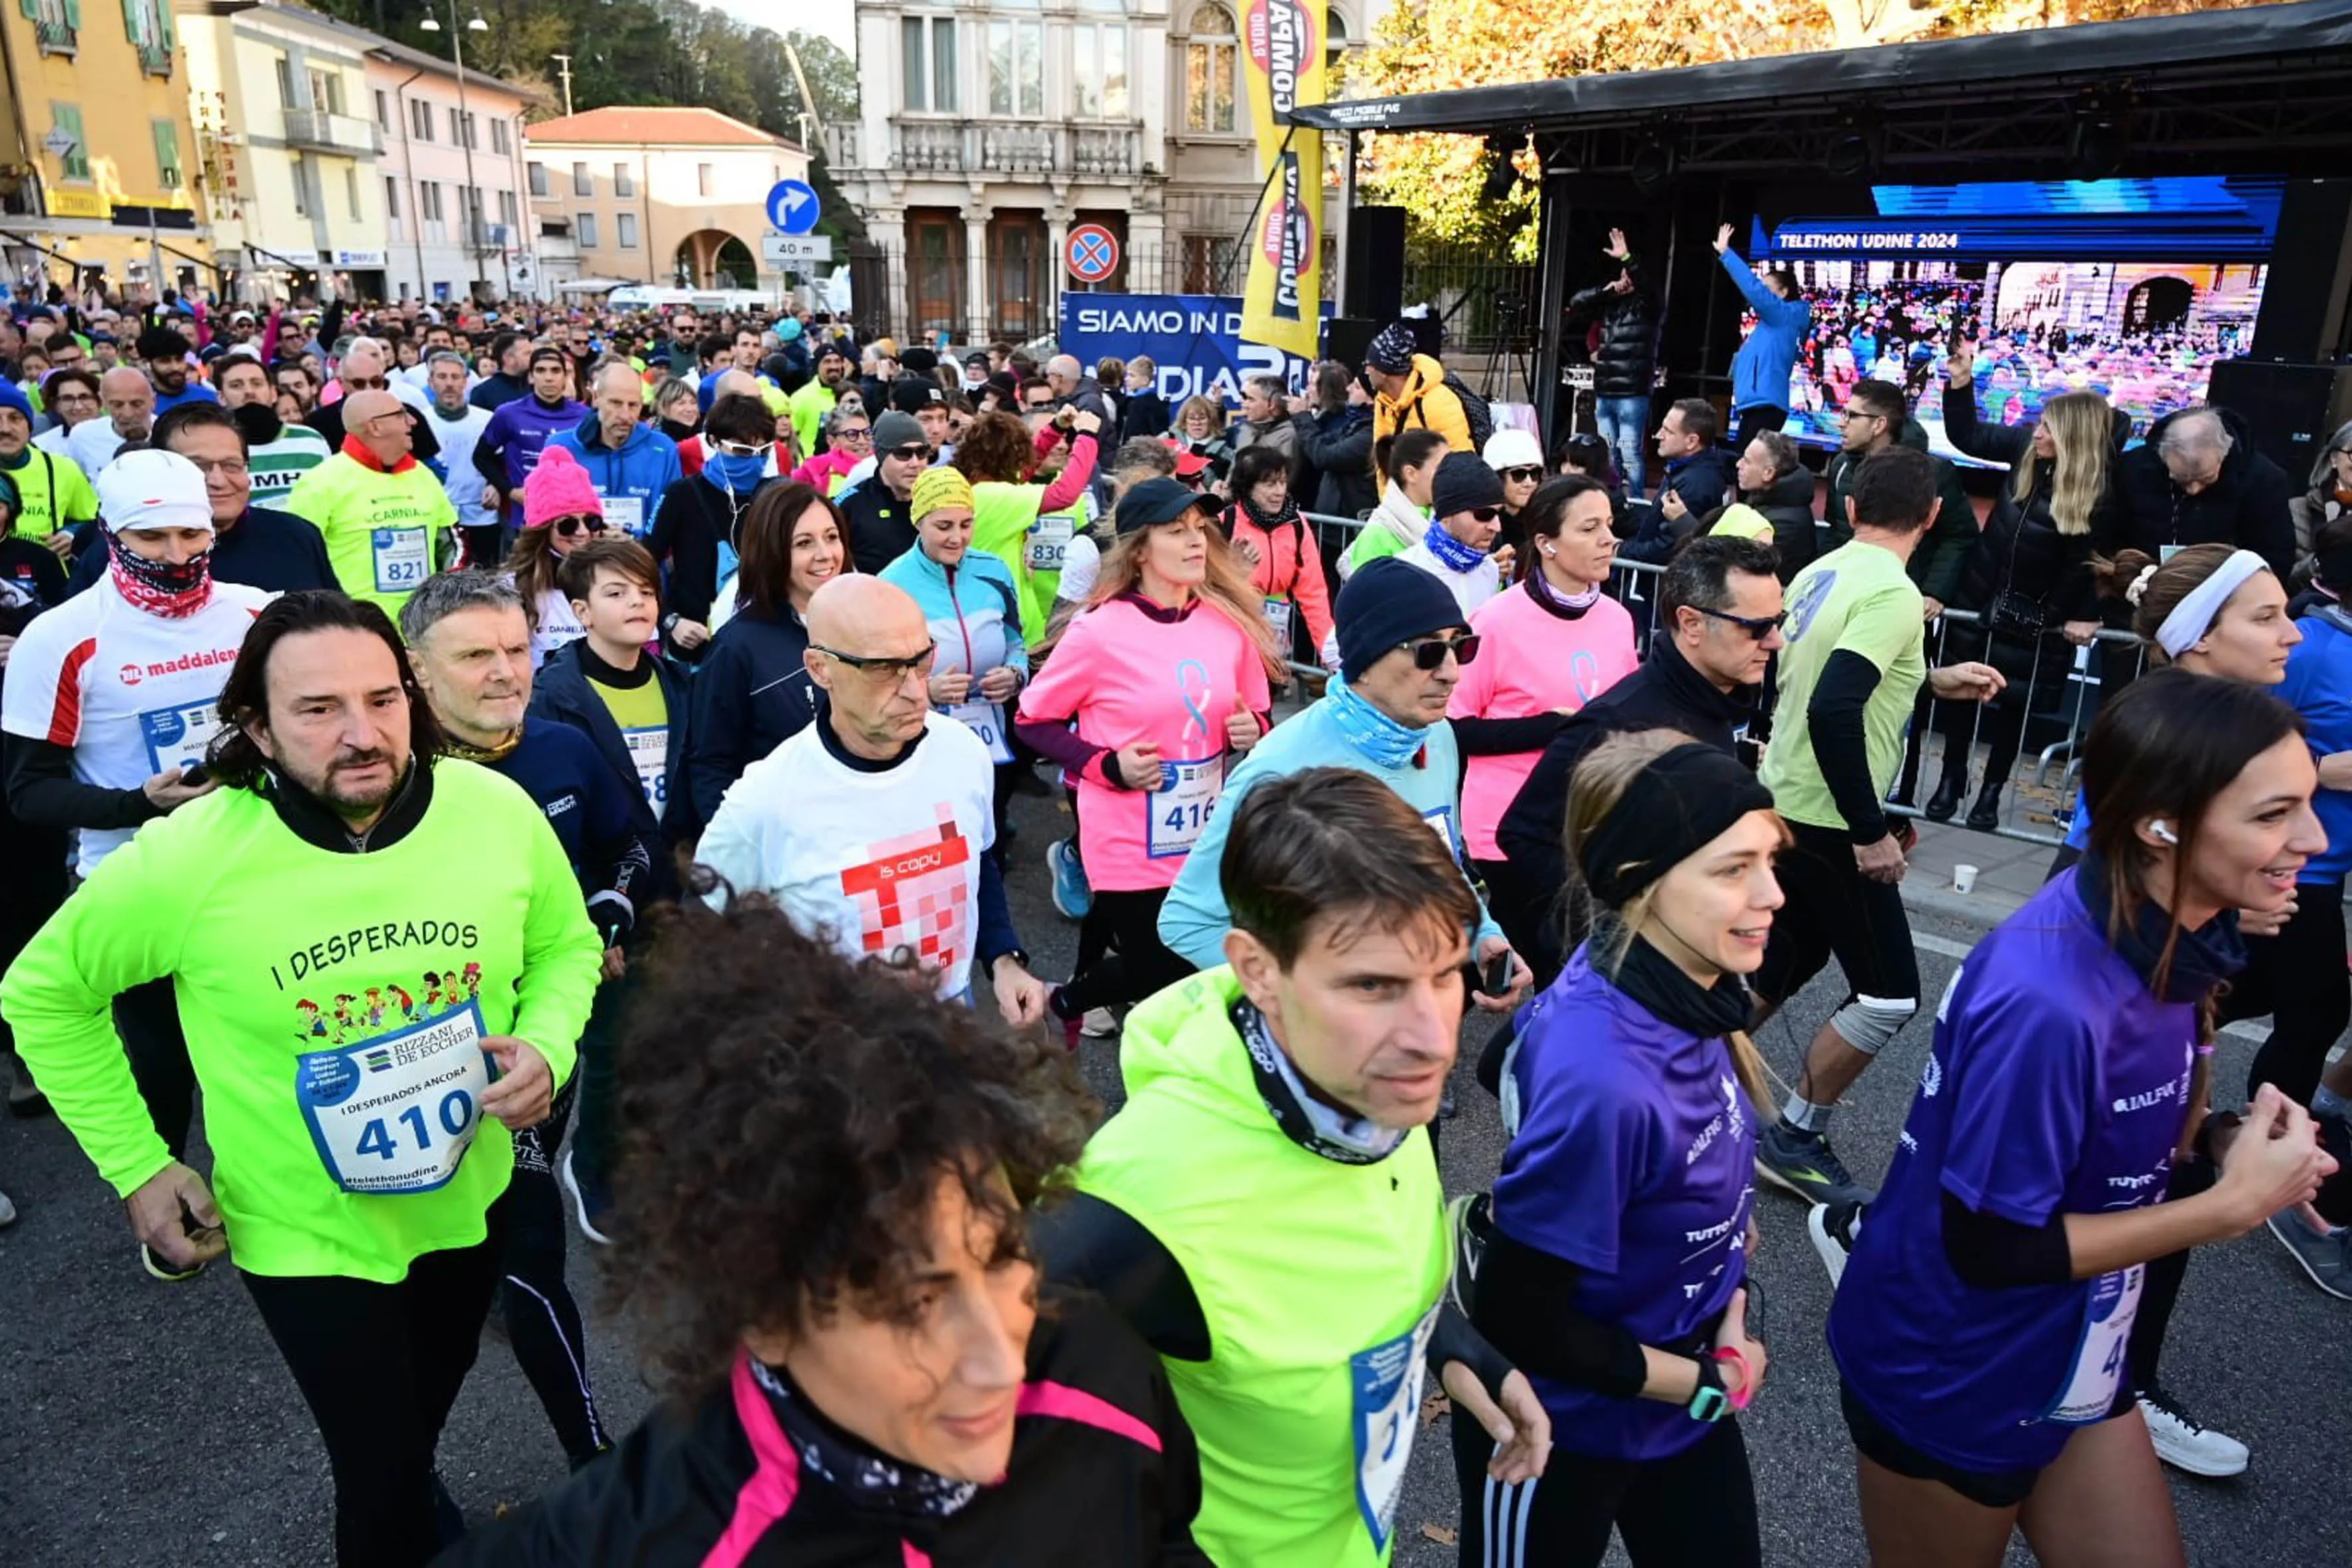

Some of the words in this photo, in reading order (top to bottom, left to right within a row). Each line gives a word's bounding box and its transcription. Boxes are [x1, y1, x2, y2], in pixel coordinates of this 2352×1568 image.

[779, 243, 797, 254] 40
[1779, 234, 1857, 248] TELETHON
[1862, 234, 1913, 248] UDINE
[1917, 234, 1958, 248] 2024
[1077, 309, 1184, 333] SIAMO
[1190, 312, 1217, 334] IN
[388, 561, 423, 580] 821
[147, 648, 241, 678] maddalen
[897, 850, 942, 874] copy
[271, 966, 284, 991] I
[289, 920, 479, 982] DESPERADOS
[393, 1024, 455, 1056] RIZZANI
[396, 1053, 418, 1066] DE
[421, 1026, 475, 1056] ECCHER
[347, 1085, 422, 1115] DESPERADOS
[424, 1065, 467, 1090] ANCORA
[356, 1089, 473, 1160] 410
[345, 1164, 439, 1184] #telethonudine
